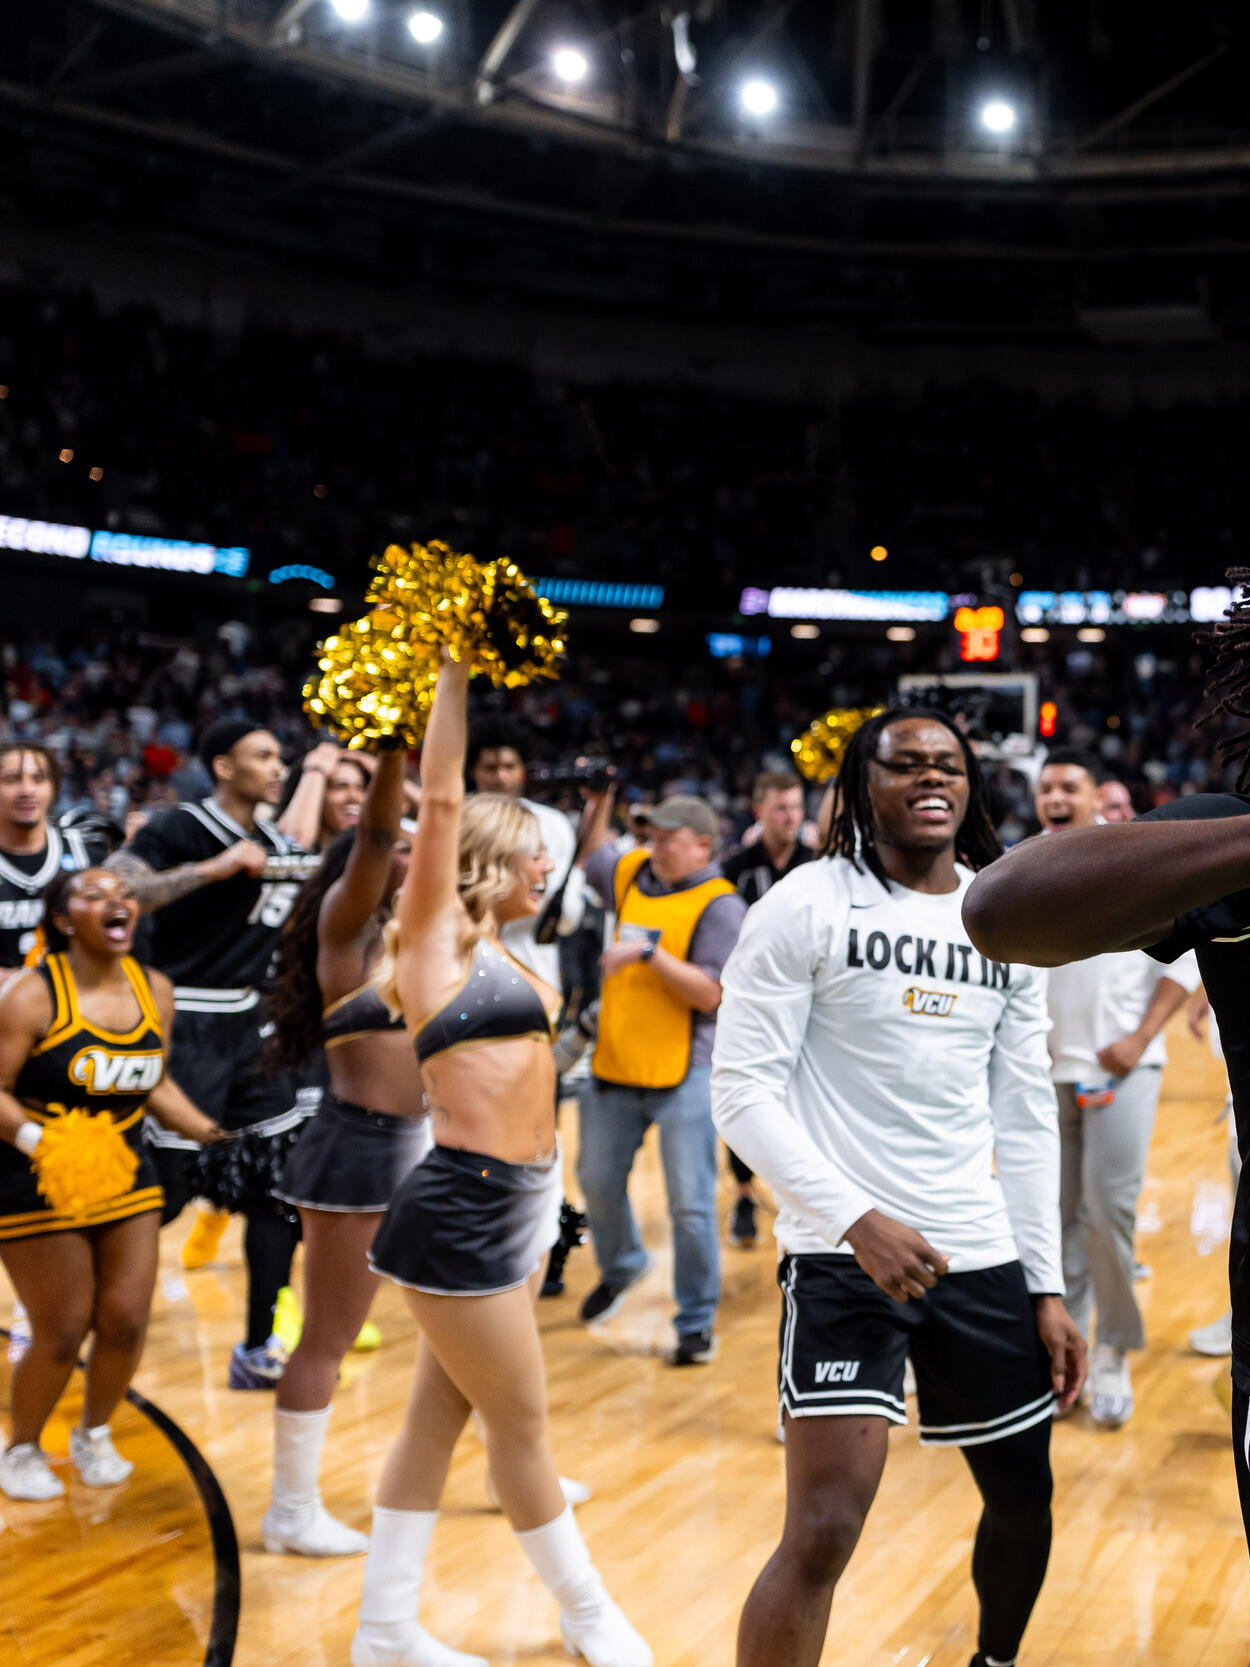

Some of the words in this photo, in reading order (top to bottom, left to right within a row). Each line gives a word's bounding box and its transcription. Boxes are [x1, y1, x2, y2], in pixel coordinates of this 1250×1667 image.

[847, 928, 937, 977] LOCK
[945, 942, 972, 982] IT
[980, 954, 1011, 990] IN
[905, 988, 957, 1016] VCU
[80, 1049, 163, 1092] VCU
[814, 1360, 860, 1383] VCU
